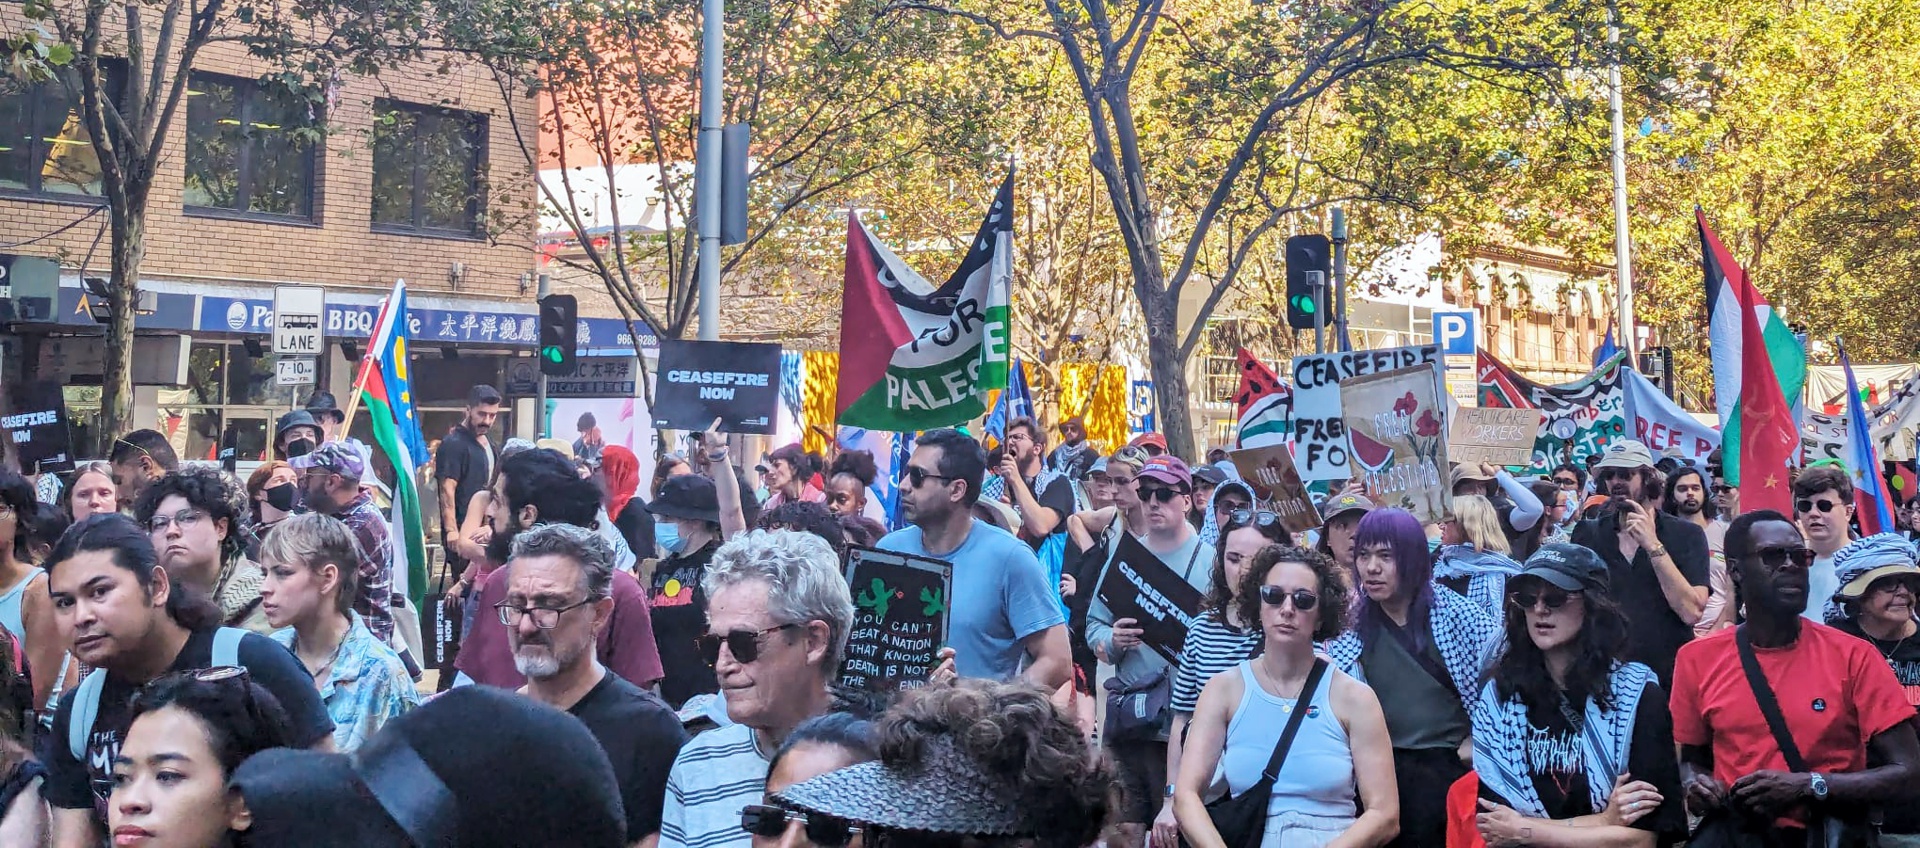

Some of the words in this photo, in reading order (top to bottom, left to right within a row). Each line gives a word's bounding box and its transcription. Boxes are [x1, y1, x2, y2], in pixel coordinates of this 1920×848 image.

[328, 309, 373, 335] BBQ
[911, 298, 986, 353] FOR
[1441, 316, 1466, 349] P
[281, 335, 314, 350] LANE
[591, 362, 629, 378] 太平洋
[667, 370, 769, 387] CEASEFIRE
[700, 387, 735, 400] NOW
[1, 410, 57, 429] CEASEFIRE
[1295, 417, 1345, 443] FRE
[1374, 409, 1408, 440] FREE
[12, 430, 30, 443] NOW
[1635, 415, 1683, 451] REE
[1365, 460, 1438, 496] PALESTINE
[1135, 593, 1166, 621] NOW
[436, 600, 444, 663] CEASEFIRE
[444, 620, 452, 642] NOW
[854, 614, 883, 625] YOU
[892, 622, 932, 634] CAN'T
[851, 628, 880, 640] BEAT
[882, 634, 889, 644] A
[892, 636, 931, 651] NATION
[850, 644, 878, 657] THAT
[884, 649, 930, 662] KNOWS
[847, 659, 879, 676] DEATH
[886, 665, 897, 677] IS
[904, 666, 929, 675] NOT
[842, 676, 865, 686] THE
[93, 730, 117, 744] THE
